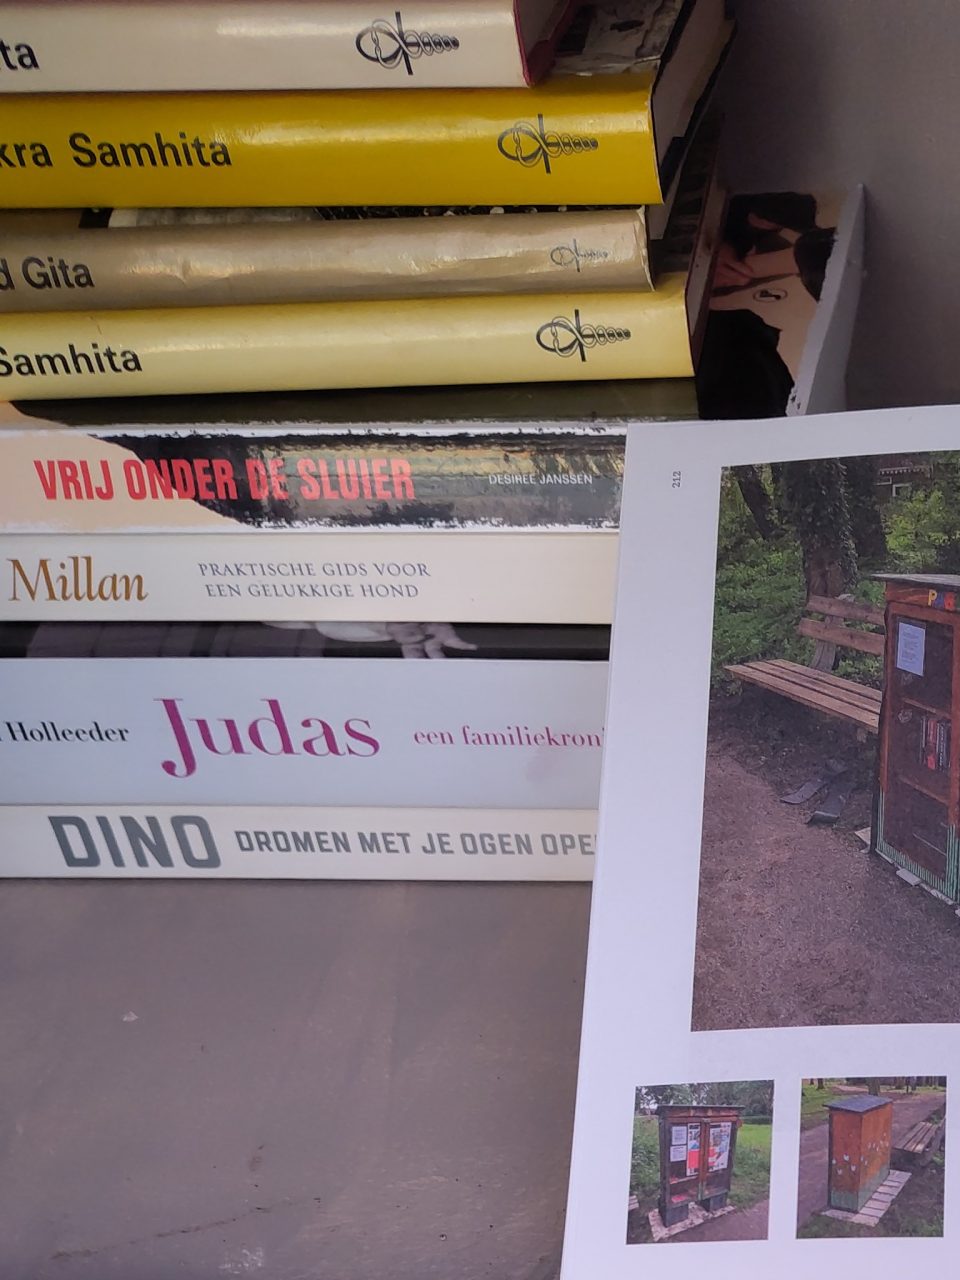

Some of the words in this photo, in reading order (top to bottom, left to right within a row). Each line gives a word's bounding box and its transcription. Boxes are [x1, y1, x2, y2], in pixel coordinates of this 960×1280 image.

[68, 131, 233, 168] Samhita
[21, 256, 95, 290] Gita
[0, 342, 143, 377] Samhita
[33, 459, 115, 501] VRIJ
[122, 458, 238, 501] ONDER
[243, 458, 289, 500] DE
[297, 458, 416, 500] SLUIER
[539, 474, 593, 485] JANSSEN
[671, 470, 682, 489] 212
[6, 555, 149, 602] Millan
[198, 562, 316, 578] PRAKTISCHE
[322, 563, 369, 577] GIDS
[373, 563, 432, 578] VOOR
[204, 584, 243, 598] EEN
[247, 584, 355, 599] GELUKKIGE
[360, 584, 420, 599] HOND
[4, 720, 130, 743] Holleeder
[153, 697, 381, 778] Judas
[413, 729, 454, 745] een
[47, 815, 222, 869] DINO
[234, 830, 352, 854] DROMEN
[357, 831, 411, 854] MET
[420, 832, 456, 855] JE
[459, 832, 533, 856] OGEN
[539, 833, 597, 856] OPE
